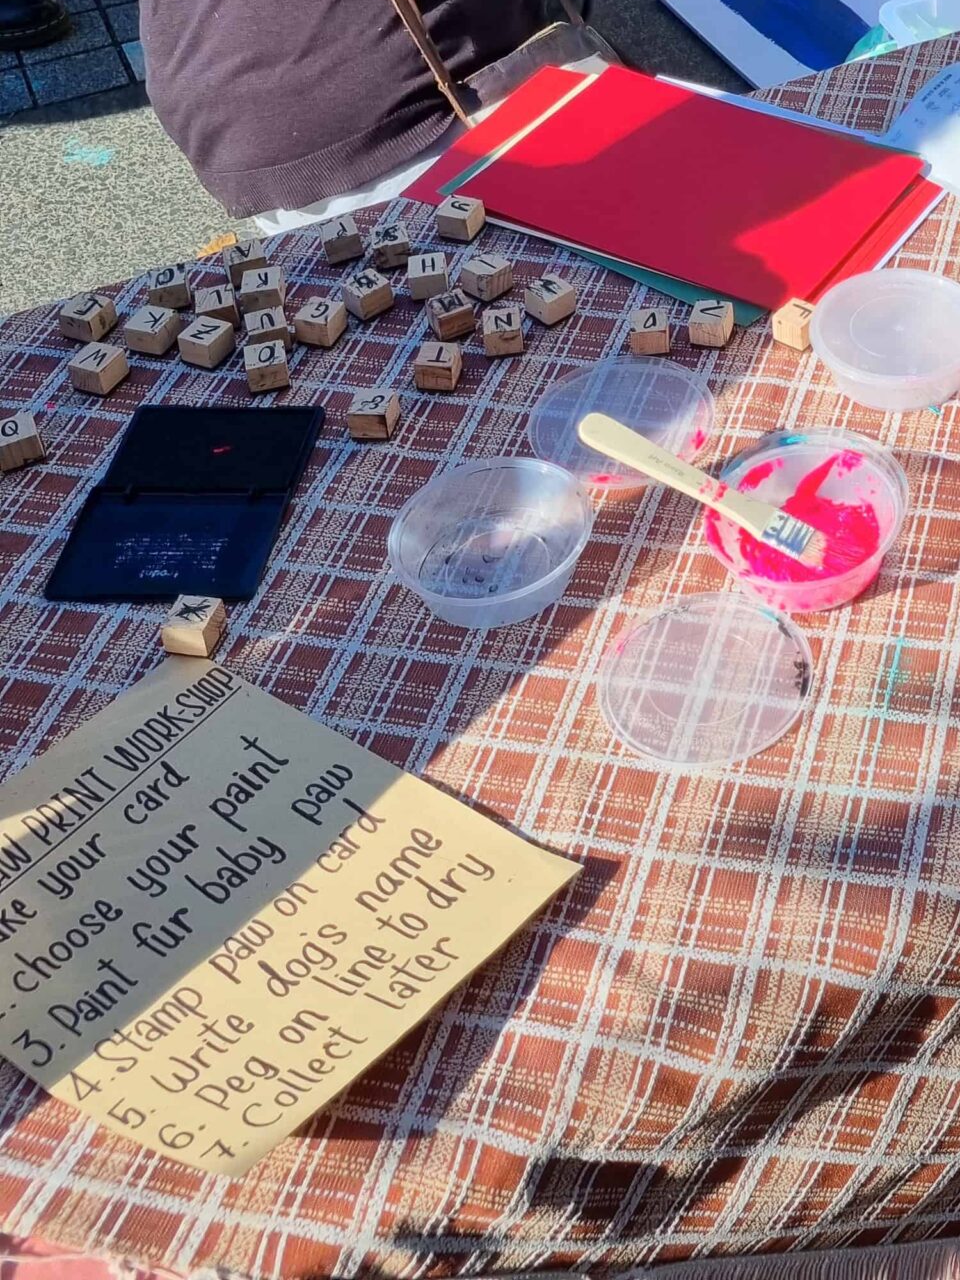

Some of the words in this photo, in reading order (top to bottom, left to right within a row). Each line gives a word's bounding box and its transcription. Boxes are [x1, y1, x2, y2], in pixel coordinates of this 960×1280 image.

[1, 420, 19, 437] Q
[21, 766, 117, 846] PRINT
[103, 667, 234, 772] WORK-SHOP
[37, 833, 107, 900] your
[123, 760, 190, 824] card
[126, 824, 200, 898] your
[208, 735, 290, 833] paint
[12, 1029, 66, 1068] 3.
[132, 907, 194, 957] fur
[184, 836, 287, 904] baby
[290, 763, 354, 825] paw
[93, 986, 209, 1074] Stamp
[208, 918, 275, 985] paw
[273, 881, 319, 918] on
[316, 797, 387, 874] card
[106, 1097, 157, 1130] 5.
[354, 827, 444, 913] name
[158, 1122, 206, 1150] 6.
[278, 1008, 330, 1045] on
[311, 943, 396, 997] line
[375, 911, 430, 941] to
[414, 852, 496, 910] dry
[200, 1139, 250, 1159] 7.
[241, 1025, 369, 1128] Collect
[363, 936, 461, 1010] later
